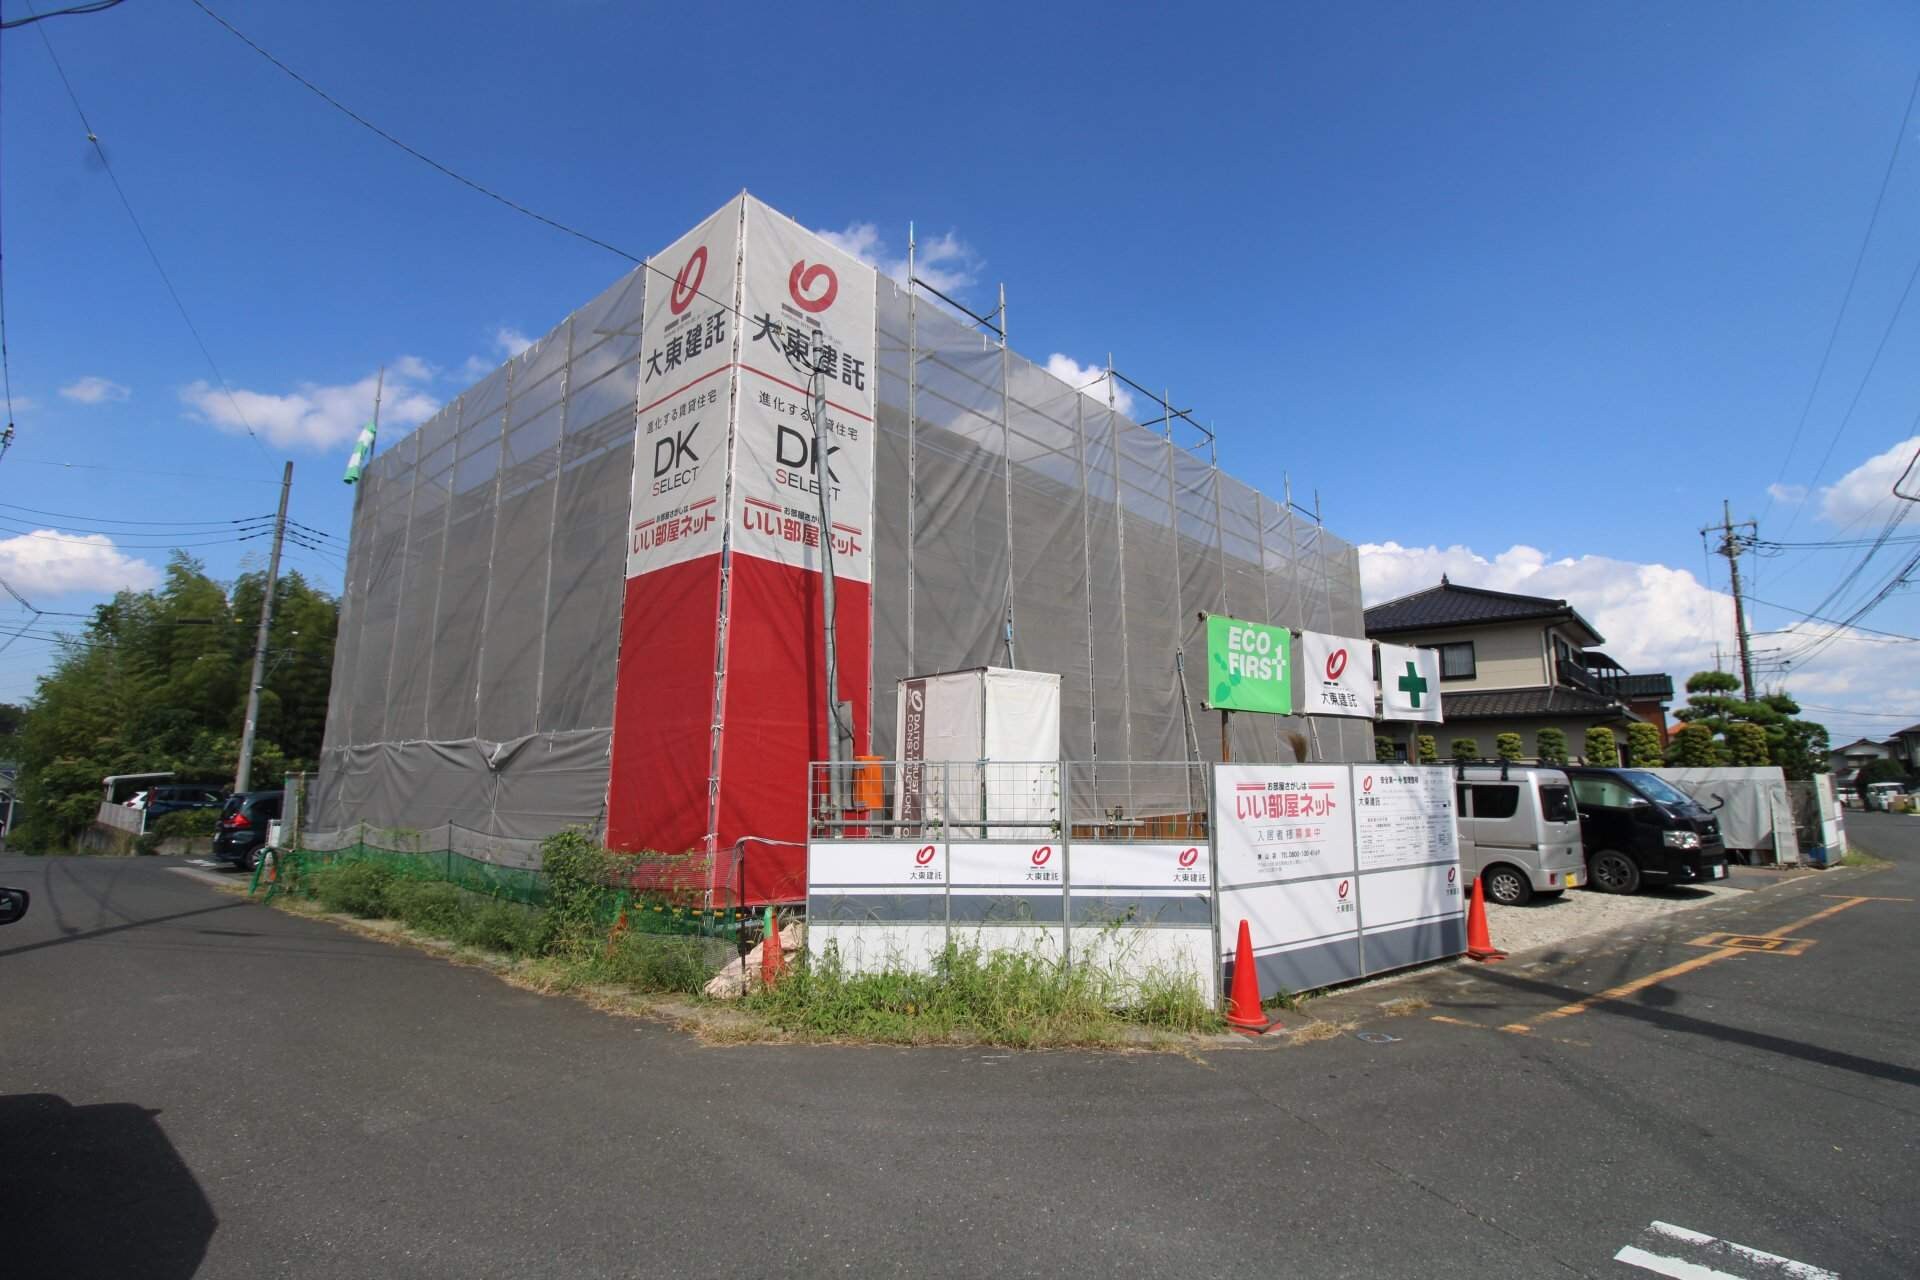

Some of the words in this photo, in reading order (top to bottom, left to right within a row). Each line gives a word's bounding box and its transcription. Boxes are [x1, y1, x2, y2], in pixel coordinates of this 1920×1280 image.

[645, 309, 726, 384] 大東建託
[752, 313, 865, 391] 大東建託
[647, 389, 717, 434] 進化する賃貸住宅
[759, 390, 858, 441] 進化する貸住宅
[654, 421, 700, 478] DK
[652, 466, 700, 496] SELECT
[775, 469, 841, 501] SELET
[634, 509, 716, 554] いい部屋ネット
[1229, 626, 1271, 655] ECO
[1229, 645, 1287, 680] FIRST
[913, 714, 921, 751] DAITO
[1267, 782, 1307, 791] お部屋さがしは
[1236, 793, 1336, 819] いい部屋ネット
